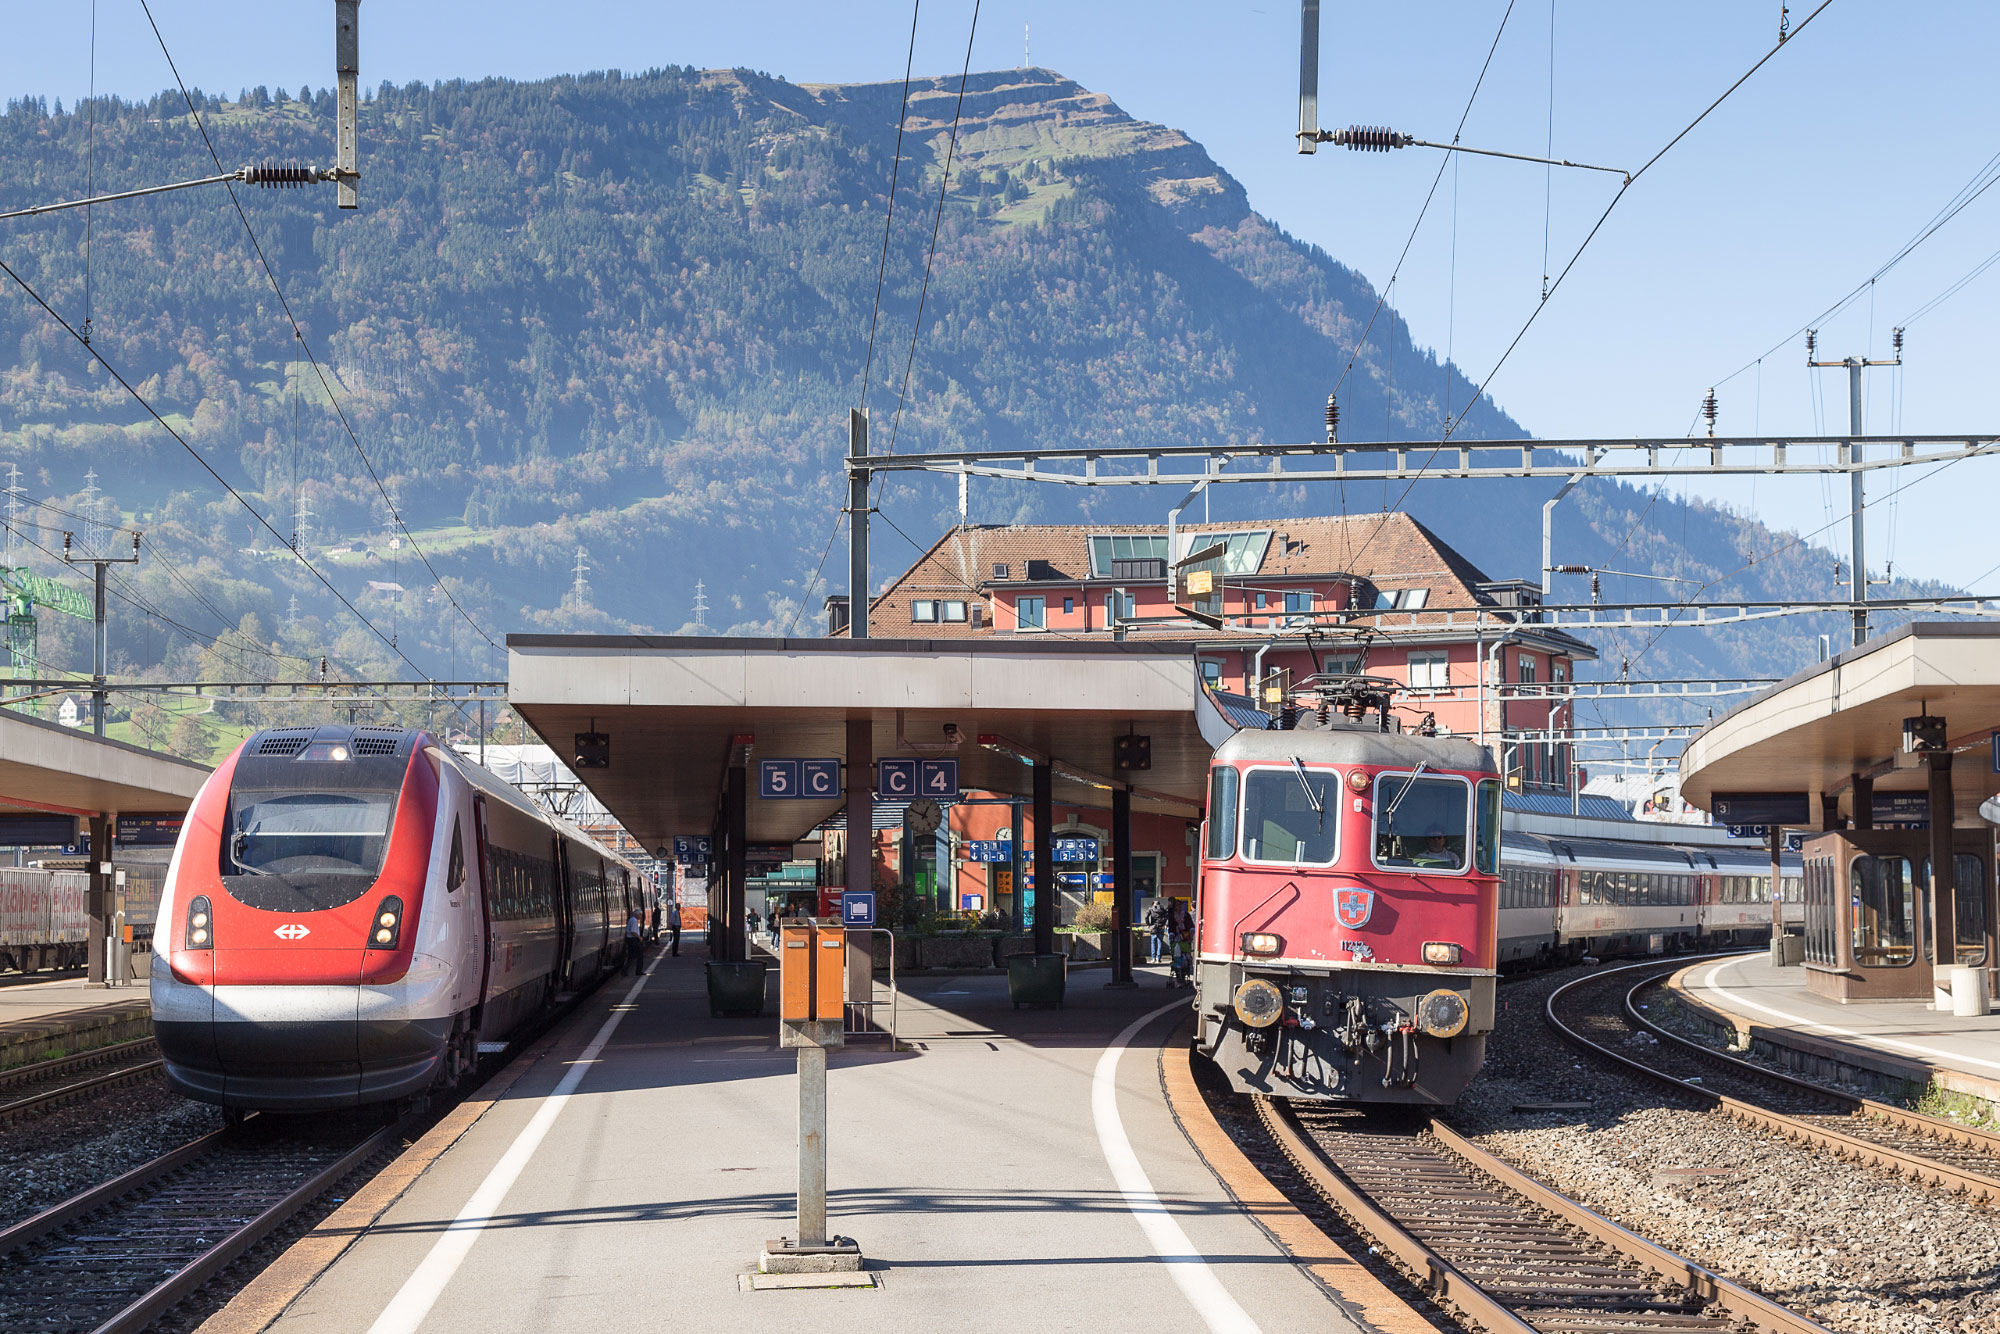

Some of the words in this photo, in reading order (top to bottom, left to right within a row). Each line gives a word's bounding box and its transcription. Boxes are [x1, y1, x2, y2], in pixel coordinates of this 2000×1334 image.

[771, 771, 787, 792] 5
[812, 771, 829, 792] C
[889, 771, 906, 792] C
[930, 771, 947, 791] 4
[1719, 805, 1727, 814] 3
[1733, 825, 1742, 835] 3
[1753, 825, 1762, 835] C
[679, 841, 688, 852] 5
[698, 841, 707, 852] C
[1793, 839, 1801, 848] 3
[682, 854, 689, 862] 5
[697, 854, 705, 862] B
